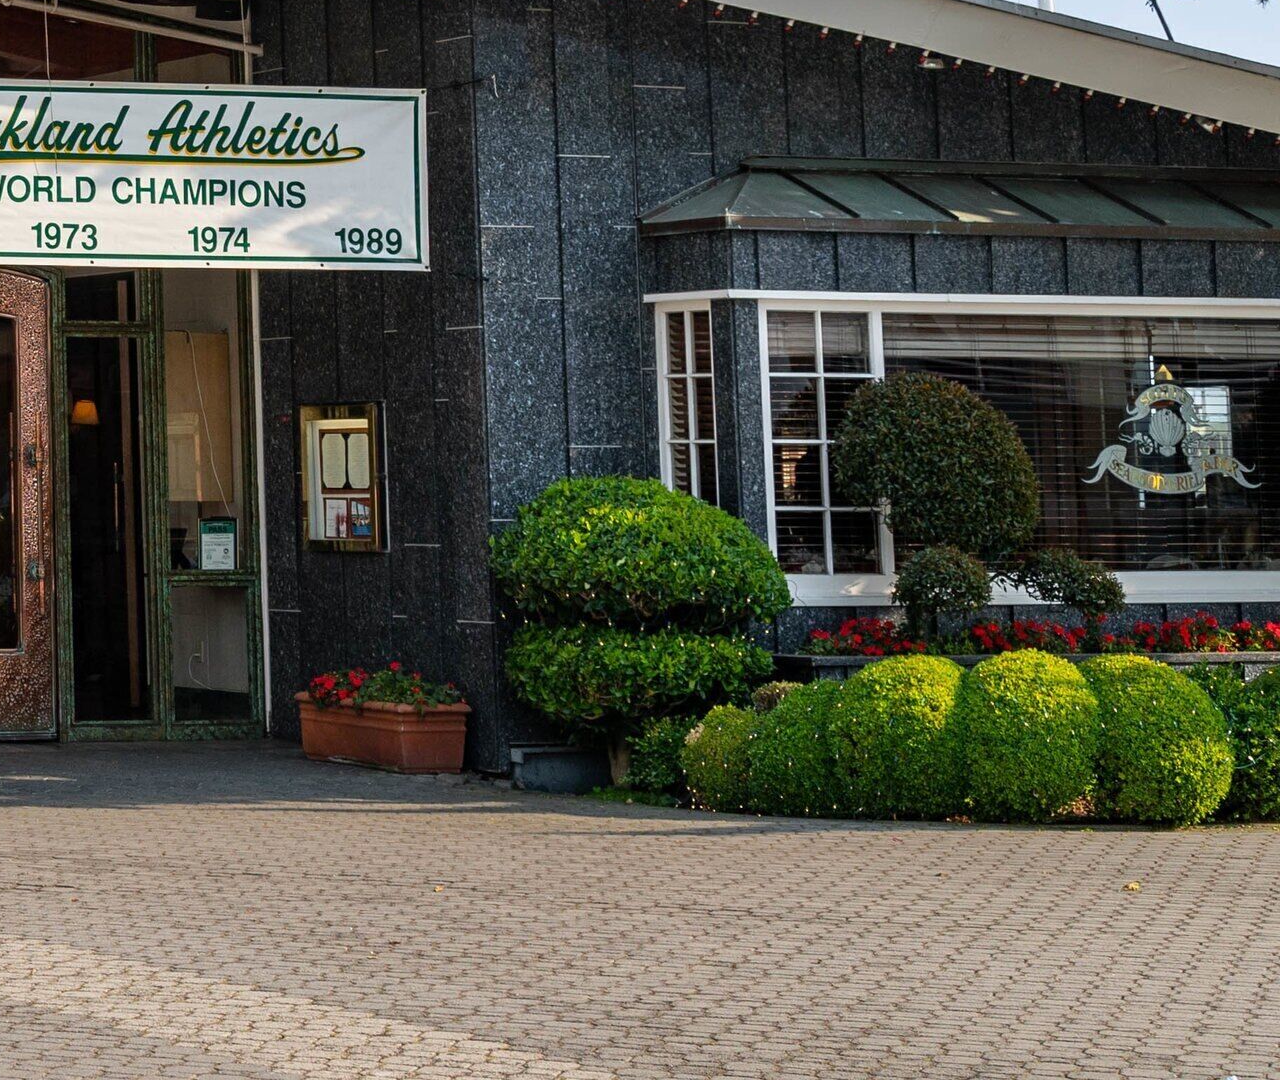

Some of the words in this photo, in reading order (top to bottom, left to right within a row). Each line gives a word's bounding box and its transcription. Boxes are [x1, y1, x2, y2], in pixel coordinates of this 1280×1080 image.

[147, 99, 342, 157] Athletics
[111, 176, 306, 209] CHAMPIONS
[31, 222, 98, 250] 1973
[188, 226, 250, 253] 1974
[335, 227, 402, 255] 1989
